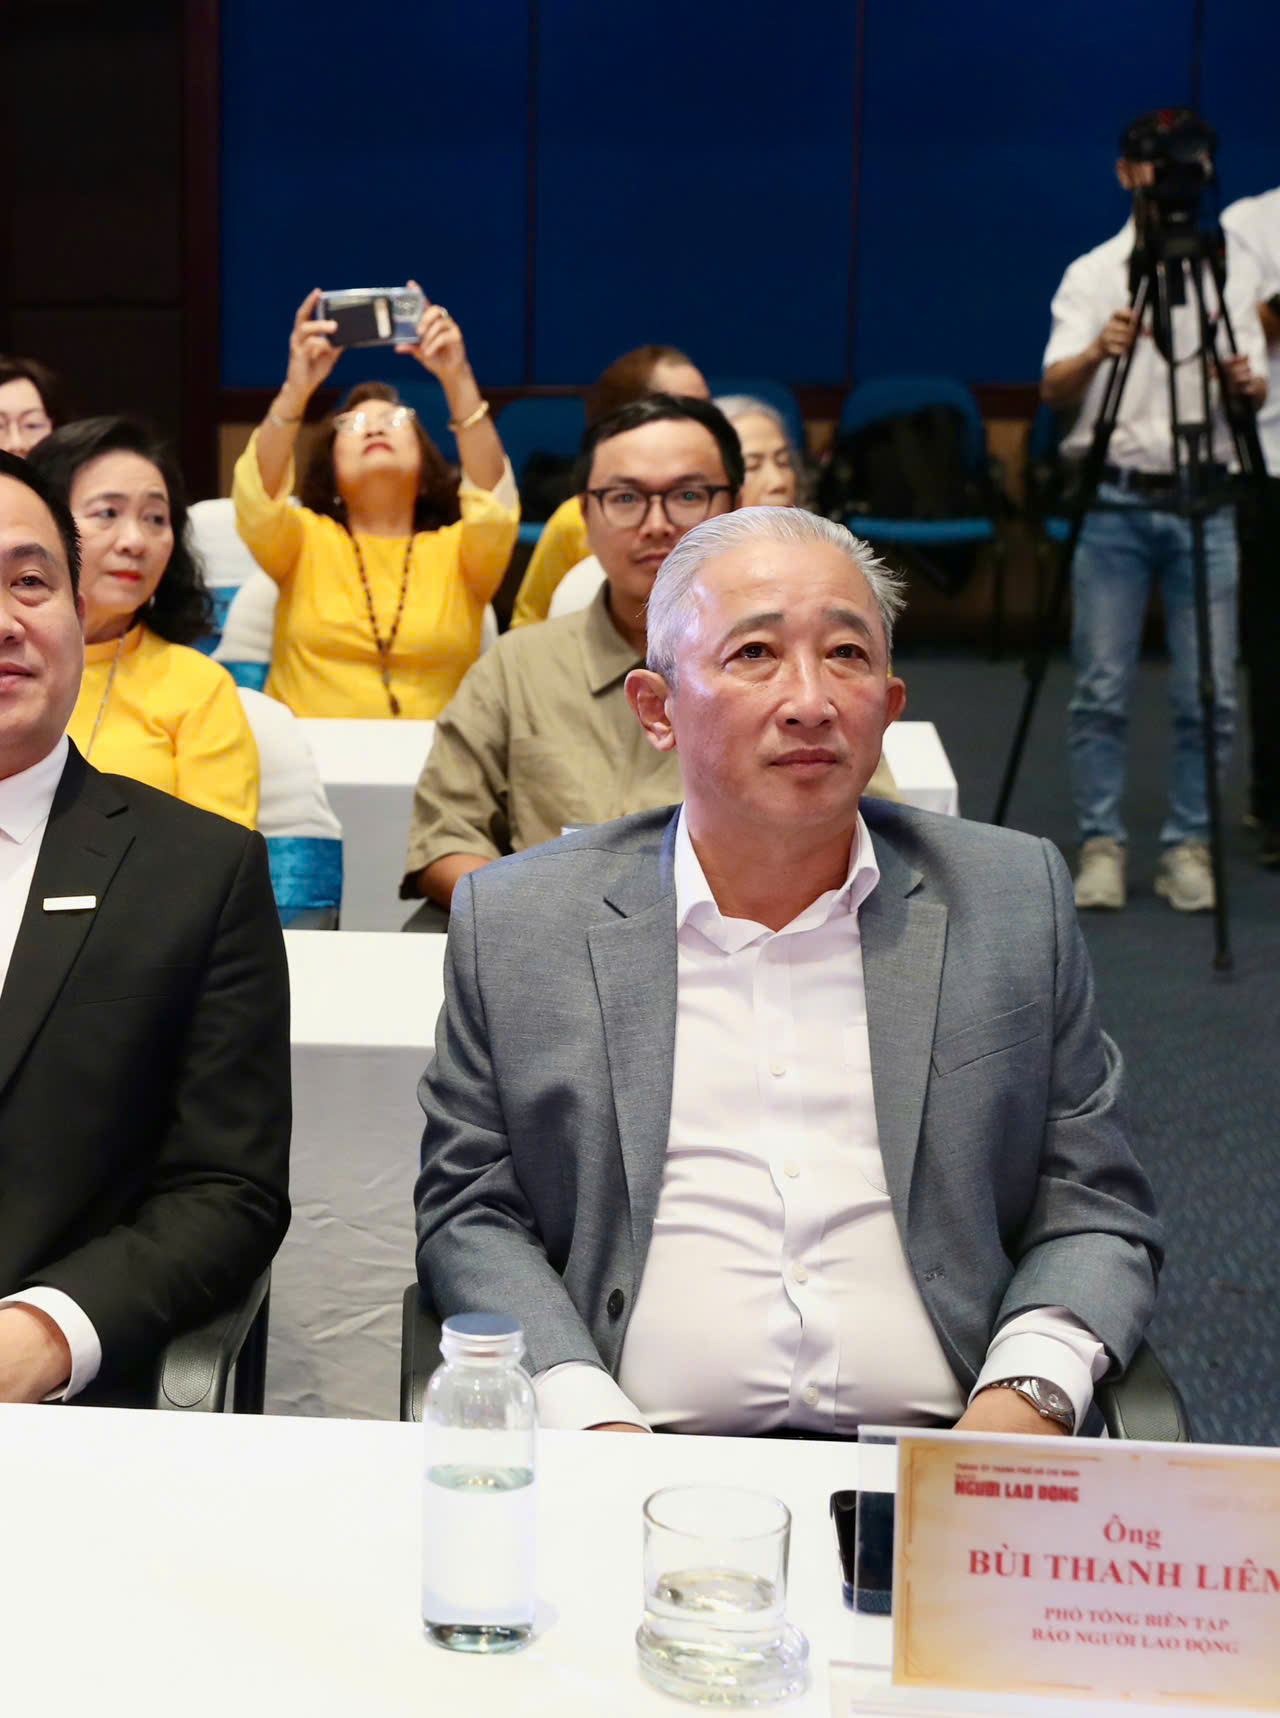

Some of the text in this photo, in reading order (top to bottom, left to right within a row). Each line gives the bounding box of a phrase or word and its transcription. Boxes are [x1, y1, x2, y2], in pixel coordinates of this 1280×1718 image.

[1004, 1482, 1034, 1500] LAO
[1102, 1512, 1162, 1550] Ông
[968, 1543, 1032, 1578] BÙI
[1044, 1553, 1185, 1589] THANH
[1141, 1634, 1180, 1650] LAO
